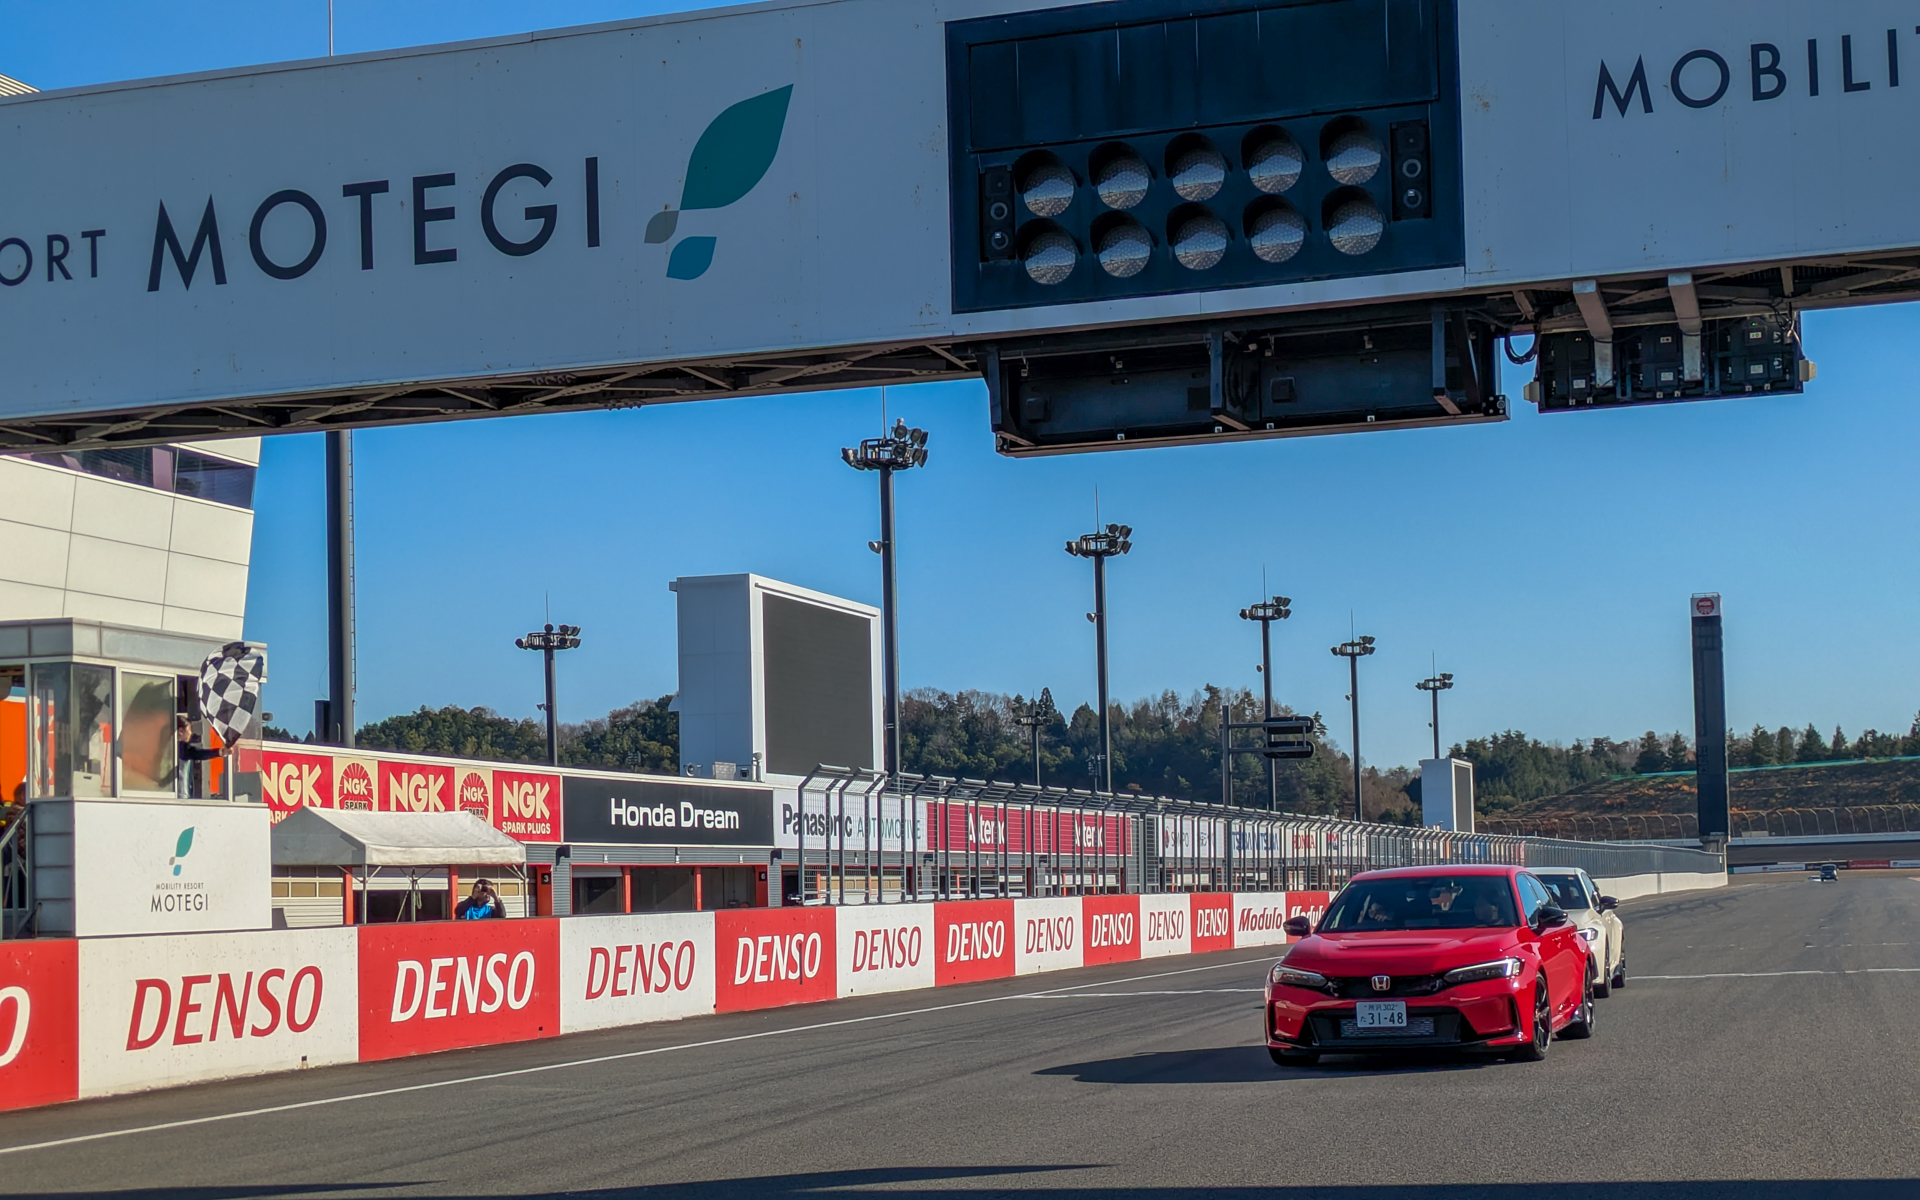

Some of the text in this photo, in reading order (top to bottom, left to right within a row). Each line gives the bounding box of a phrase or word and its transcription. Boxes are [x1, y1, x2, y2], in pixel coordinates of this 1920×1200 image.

[1593, 26, 1920, 119] MOBILI
[147, 156, 600, 292] MOTEGI
[256, 761, 323, 808] NGK
[343, 777, 369, 796] NGK
[389, 771, 446, 813] NGK
[463, 786, 485, 803] NGK
[502, 780, 551, 820] NGK
[502, 821, 551, 835] SPARK PLUGS
[610, 798, 740, 830] Honda Dream
[150, 893, 209, 913] MOTEGI
[155, 882, 204, 890] MOBILITY RESORT
[1025, 916, 1074, 954] DENSO
[1091, 911, 1134, 948] DENSO
[1149, 911, 1184, 942] DENSO
[1196, 907, 1229, 938] DENSO
[1238, 906, 1283, 932] Modulo
[734, 932, 822, 985] DENSO
[852, 926, 922, 973] DENSO
[946, 919, 1005, 964] DENSO
[391, 950, 535, 1023] DENSO
[586, 940, 695, 1000] DENSO
[126, 965, 323, 1051] DENSO
[1367, 1011, 1404, 1025] 31-48
